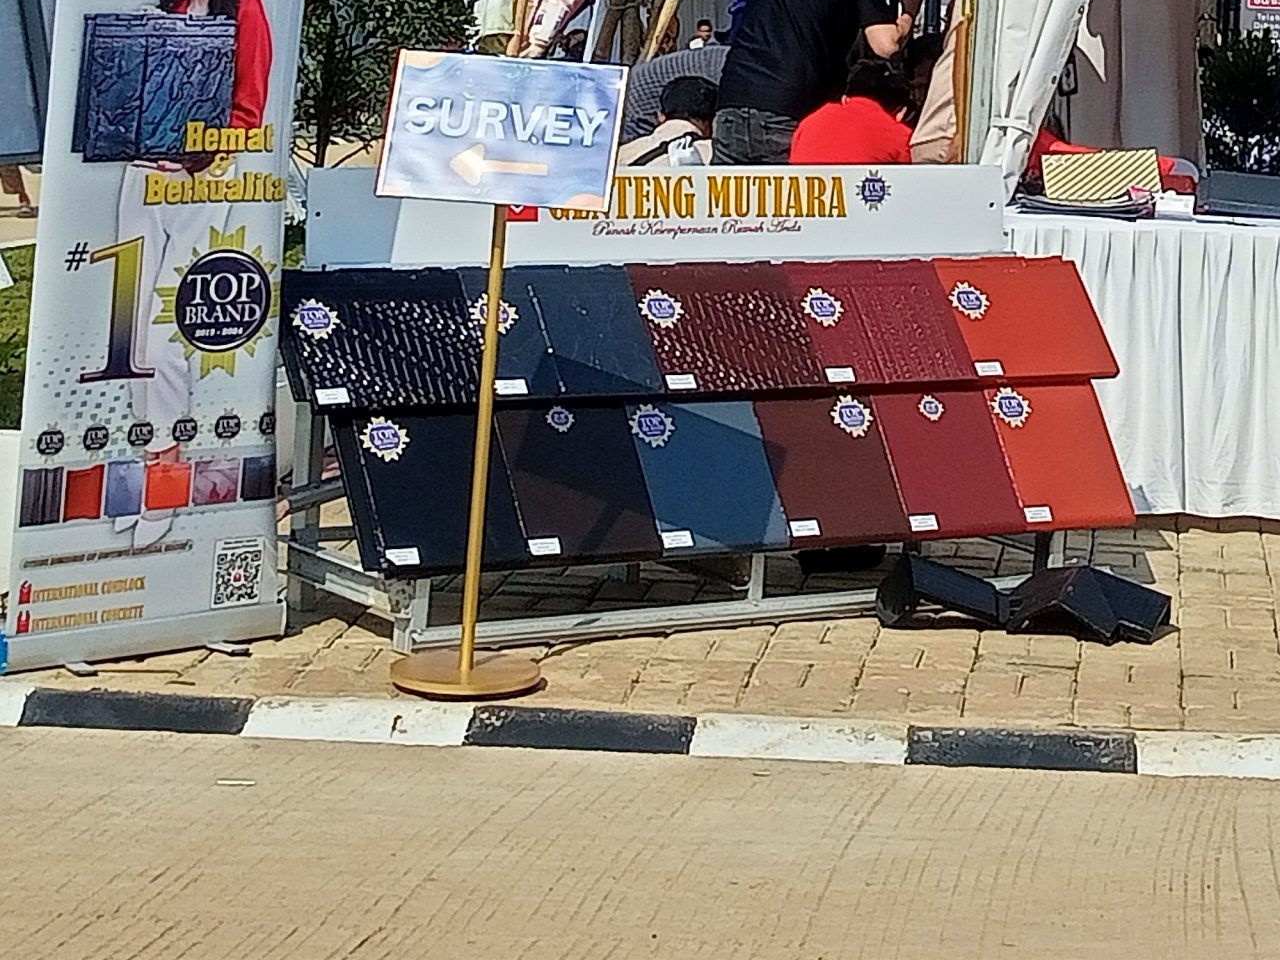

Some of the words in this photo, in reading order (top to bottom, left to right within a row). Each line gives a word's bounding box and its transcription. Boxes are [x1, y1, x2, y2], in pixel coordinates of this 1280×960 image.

[185, 120, 275, 153] Hemat
[403, 97, 607, 148] SURVEY
[549, 175, 696, 221] TENG
[707, 175, 848, 218] MUTIARA
[186, 272, 262, 305] TOP
[184, 304, 261, 325] BRAND
